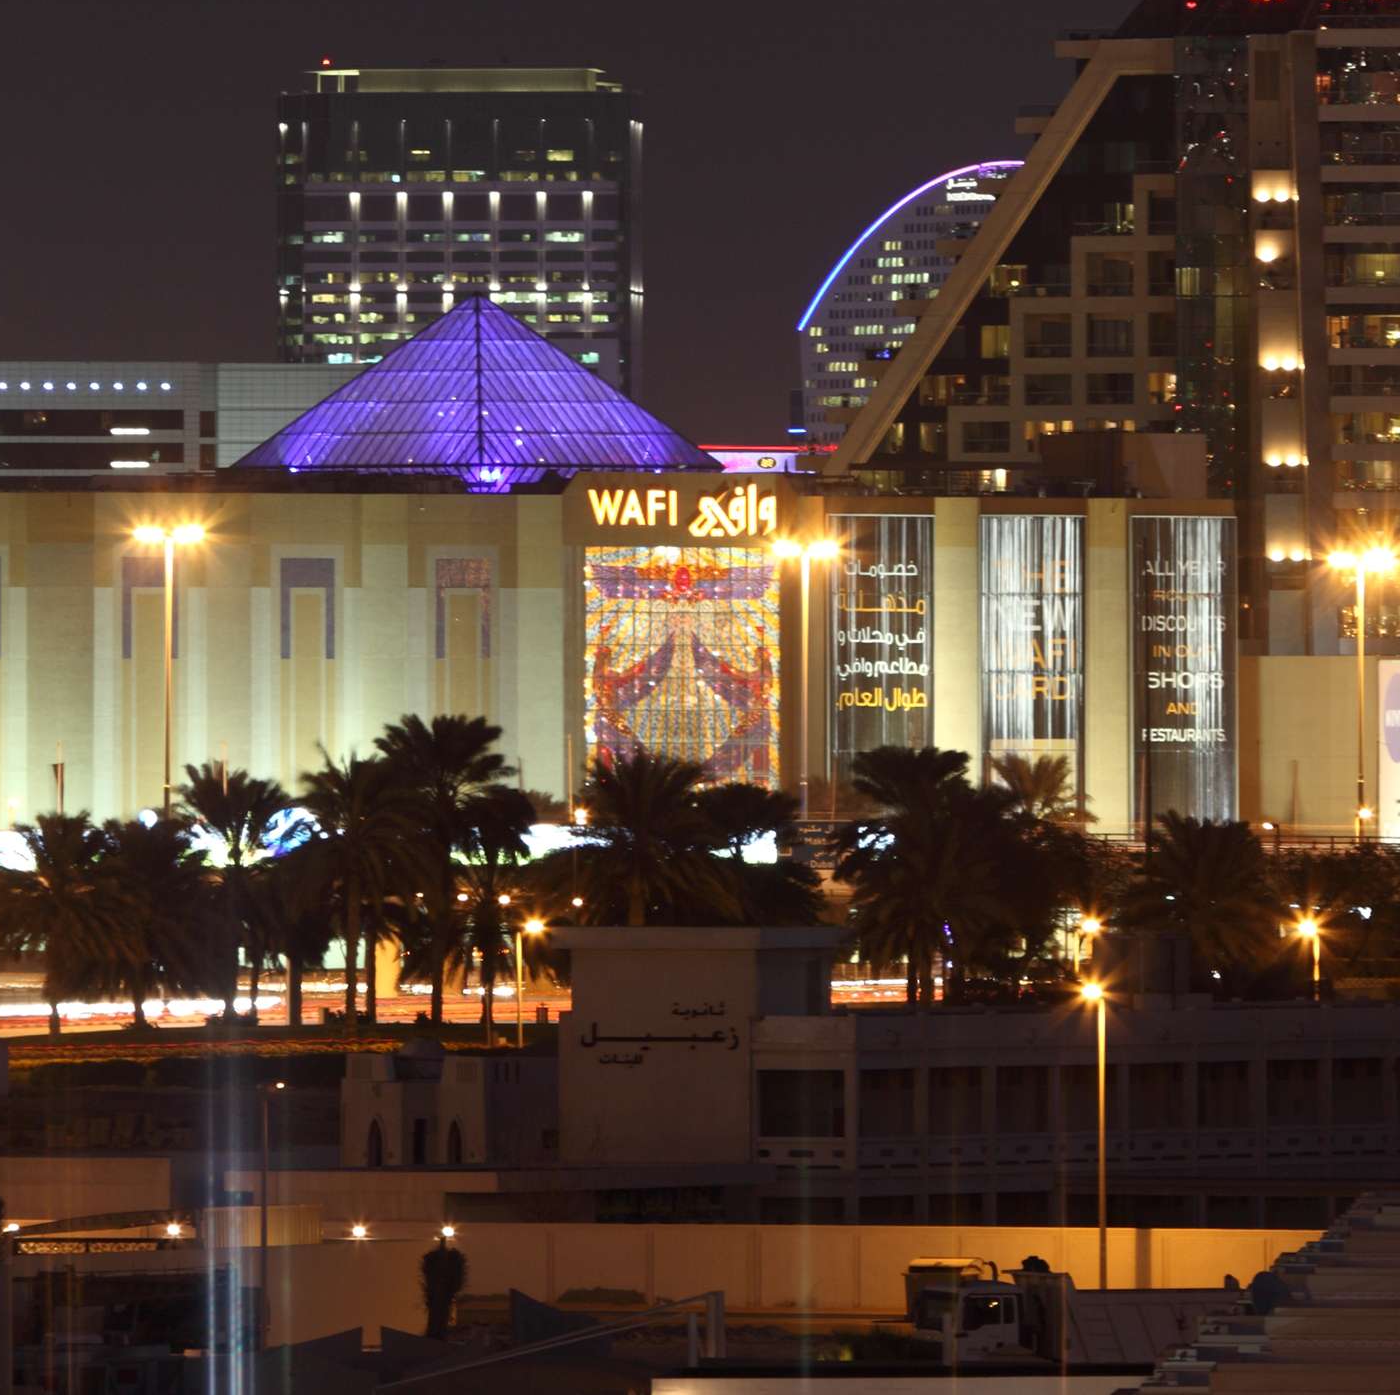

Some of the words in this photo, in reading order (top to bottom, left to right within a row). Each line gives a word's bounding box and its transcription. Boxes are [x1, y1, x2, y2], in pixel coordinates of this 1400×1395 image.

[587, 488, 678, 526] WAFI
[687, 483, 777, 538] وافي
[844, 559, 919, 579] خصومات
[1141, 560, 1176, 576] ALL
[1176, 560, 1227, 576] YER
[1152, 589, 1219, 603] ROU
[1141, 615, 1227, 632] DISCOUTS
[894, 626, 927, 651] في
[1152, 645, 1172, 658] IN
[1175, 644, 1215, 659] OU
[874, 657, 930, 678] مطاعم
[1147, 671, 1225, 689] SHOPS
[883, 687, 929, 712] طوال
[1166, 702, 1202, 715] AND
[579, 1022, 740, 1051] زعبيل
